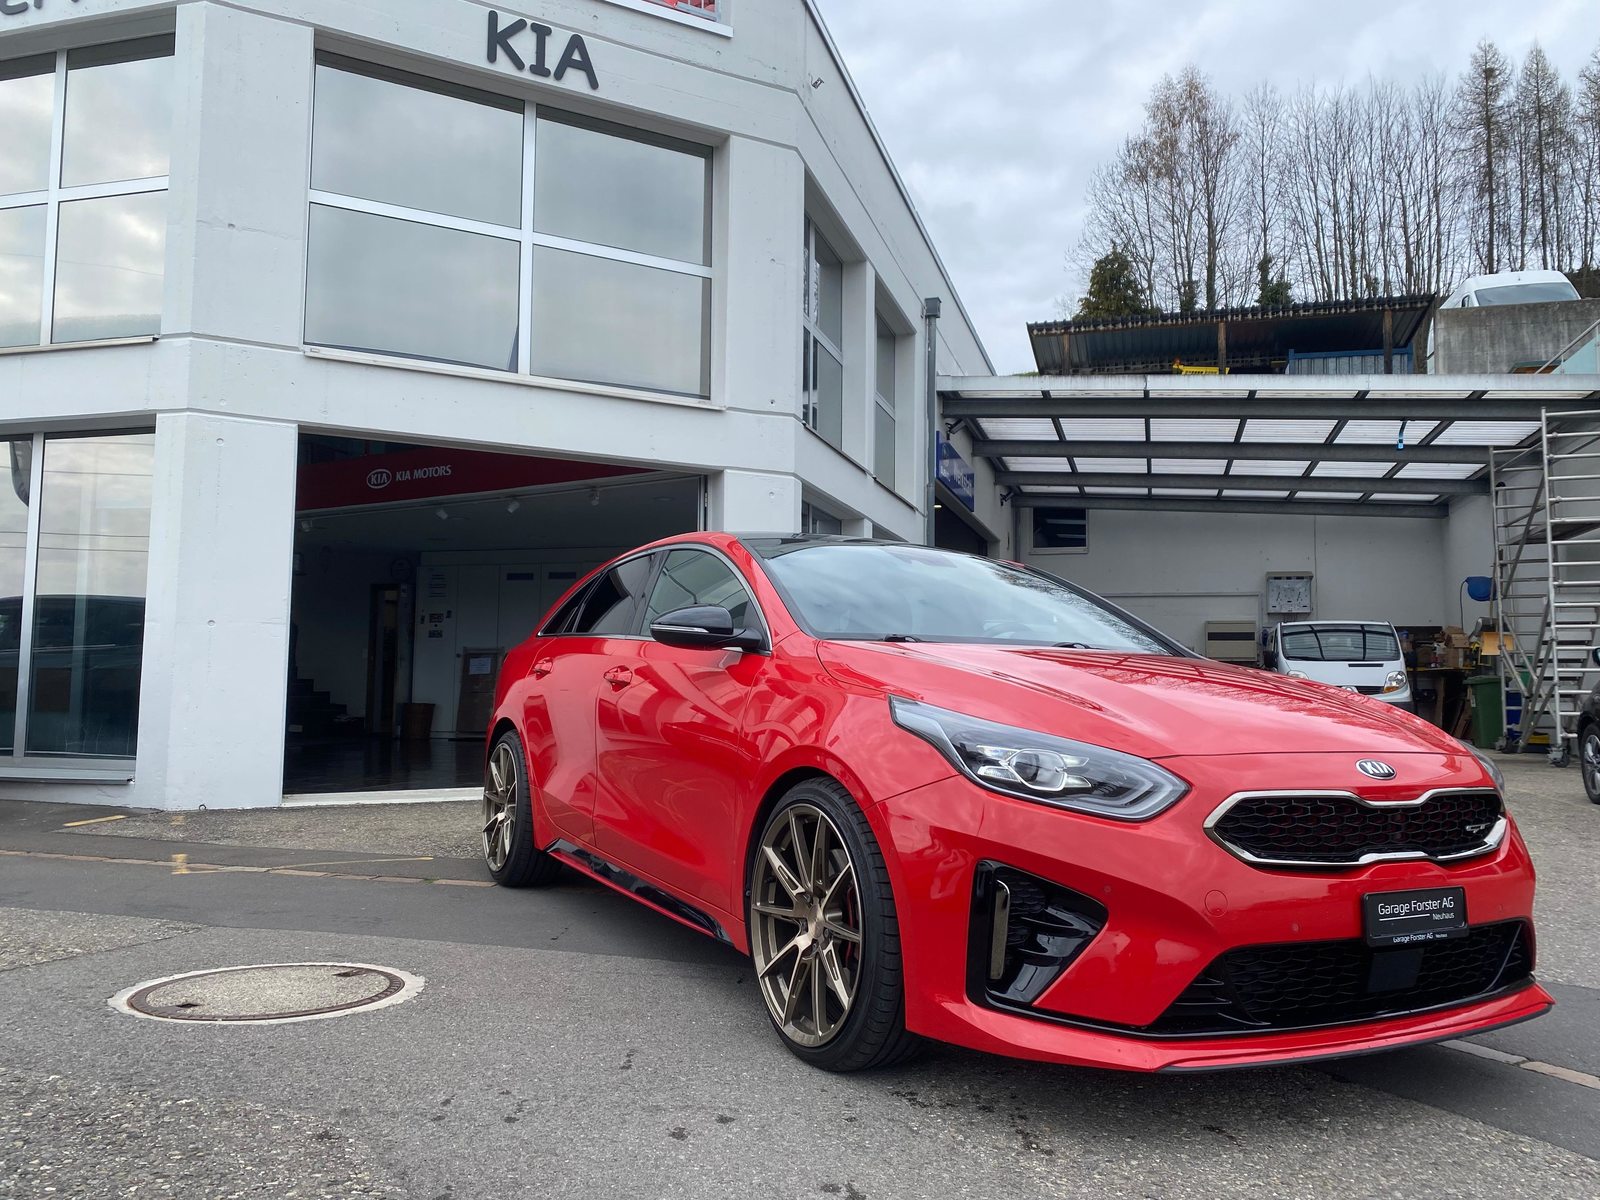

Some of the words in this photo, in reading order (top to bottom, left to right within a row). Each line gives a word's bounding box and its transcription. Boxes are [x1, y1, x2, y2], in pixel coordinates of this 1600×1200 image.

[487, 10, 599, 90] KIA
[371, 472, 388, 485] KIA
[395, 470, 411, 481] KIA
[413, 465, 452, 480] MOTORS
[1360, 761, 1395, 774] KIA
[1378, 903, 1410, 916] Garage
[1411, 899, 1441, 912] Forster
[1442, 896, 1454, 909] AG
[1432, 912, 1455, 921] Neuhaus
